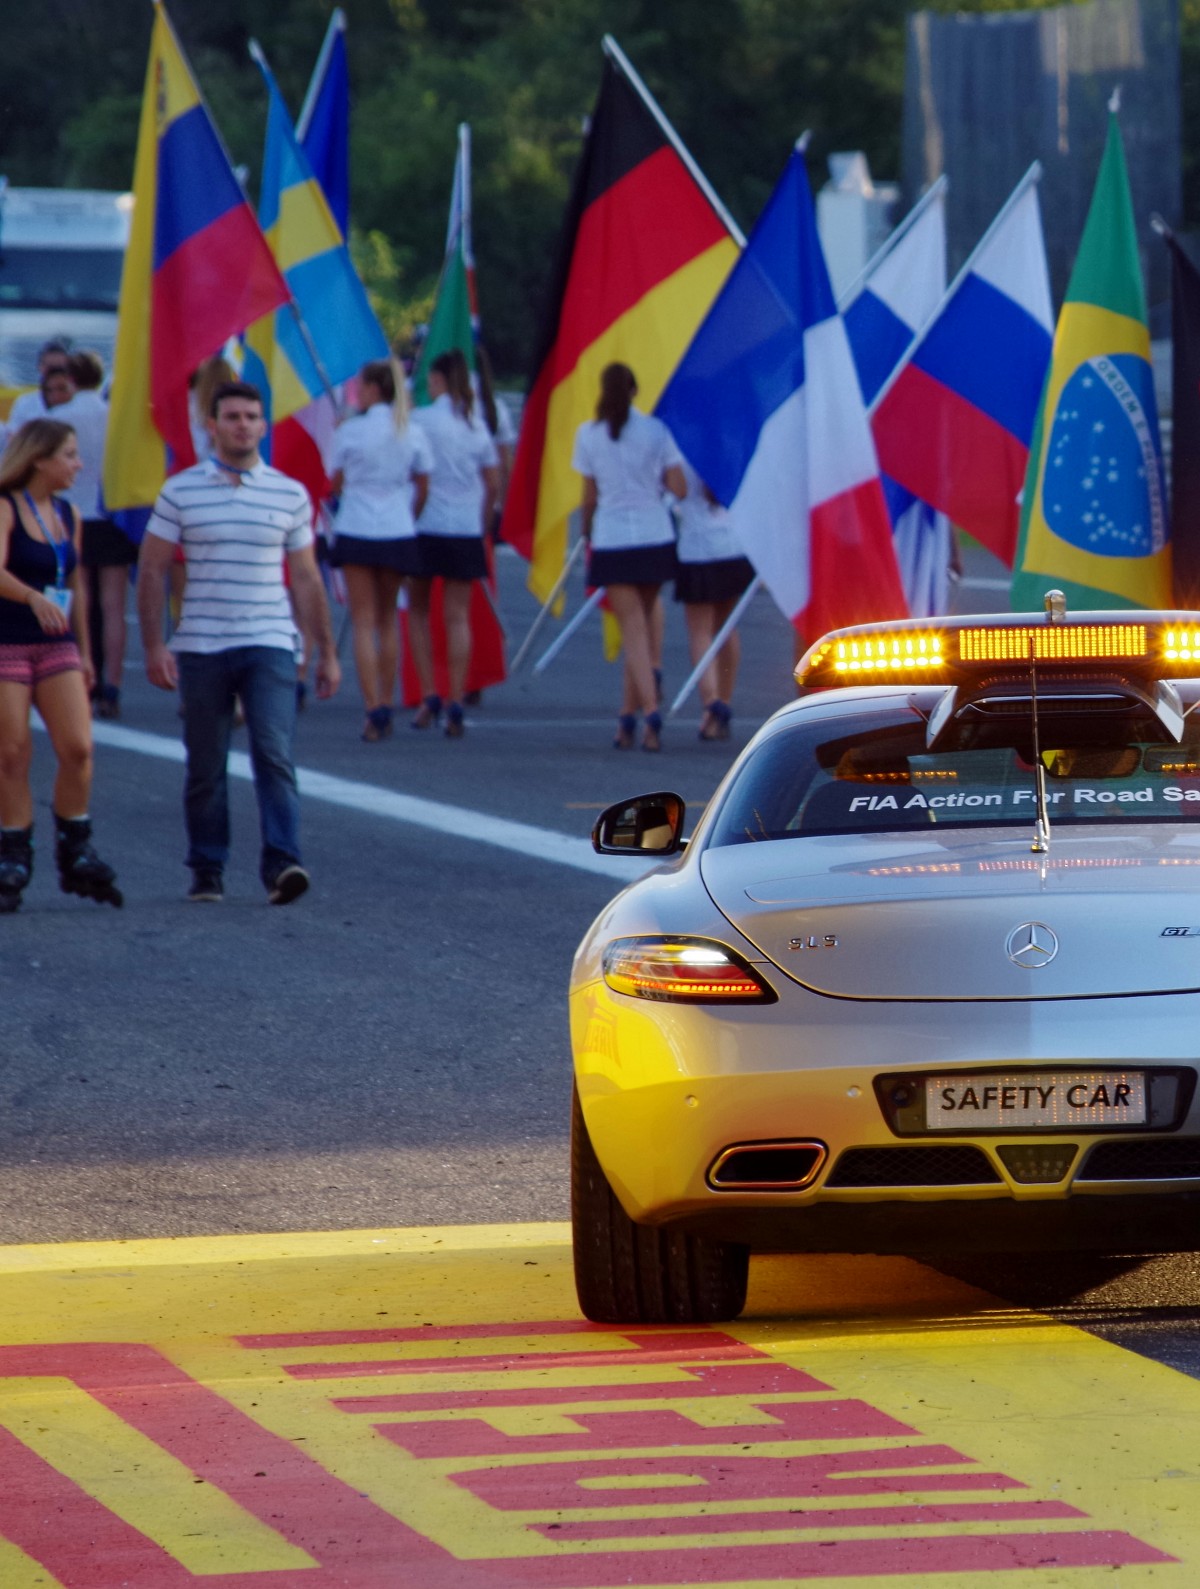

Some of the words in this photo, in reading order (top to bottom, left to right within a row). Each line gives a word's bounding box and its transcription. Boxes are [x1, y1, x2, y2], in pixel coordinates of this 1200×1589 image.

[1097, 360, 1138, 413] ORDEM
[849, 795, 898, 811] FIA
[903, 793, 1002, 808] Action
[1074, 787, 1154, 803] Road
[788, 934, 839, 950] SLS
[941, 1086, 1055, 1111] SAFETY
[1066, 1083, 1131, 1108] CAR
